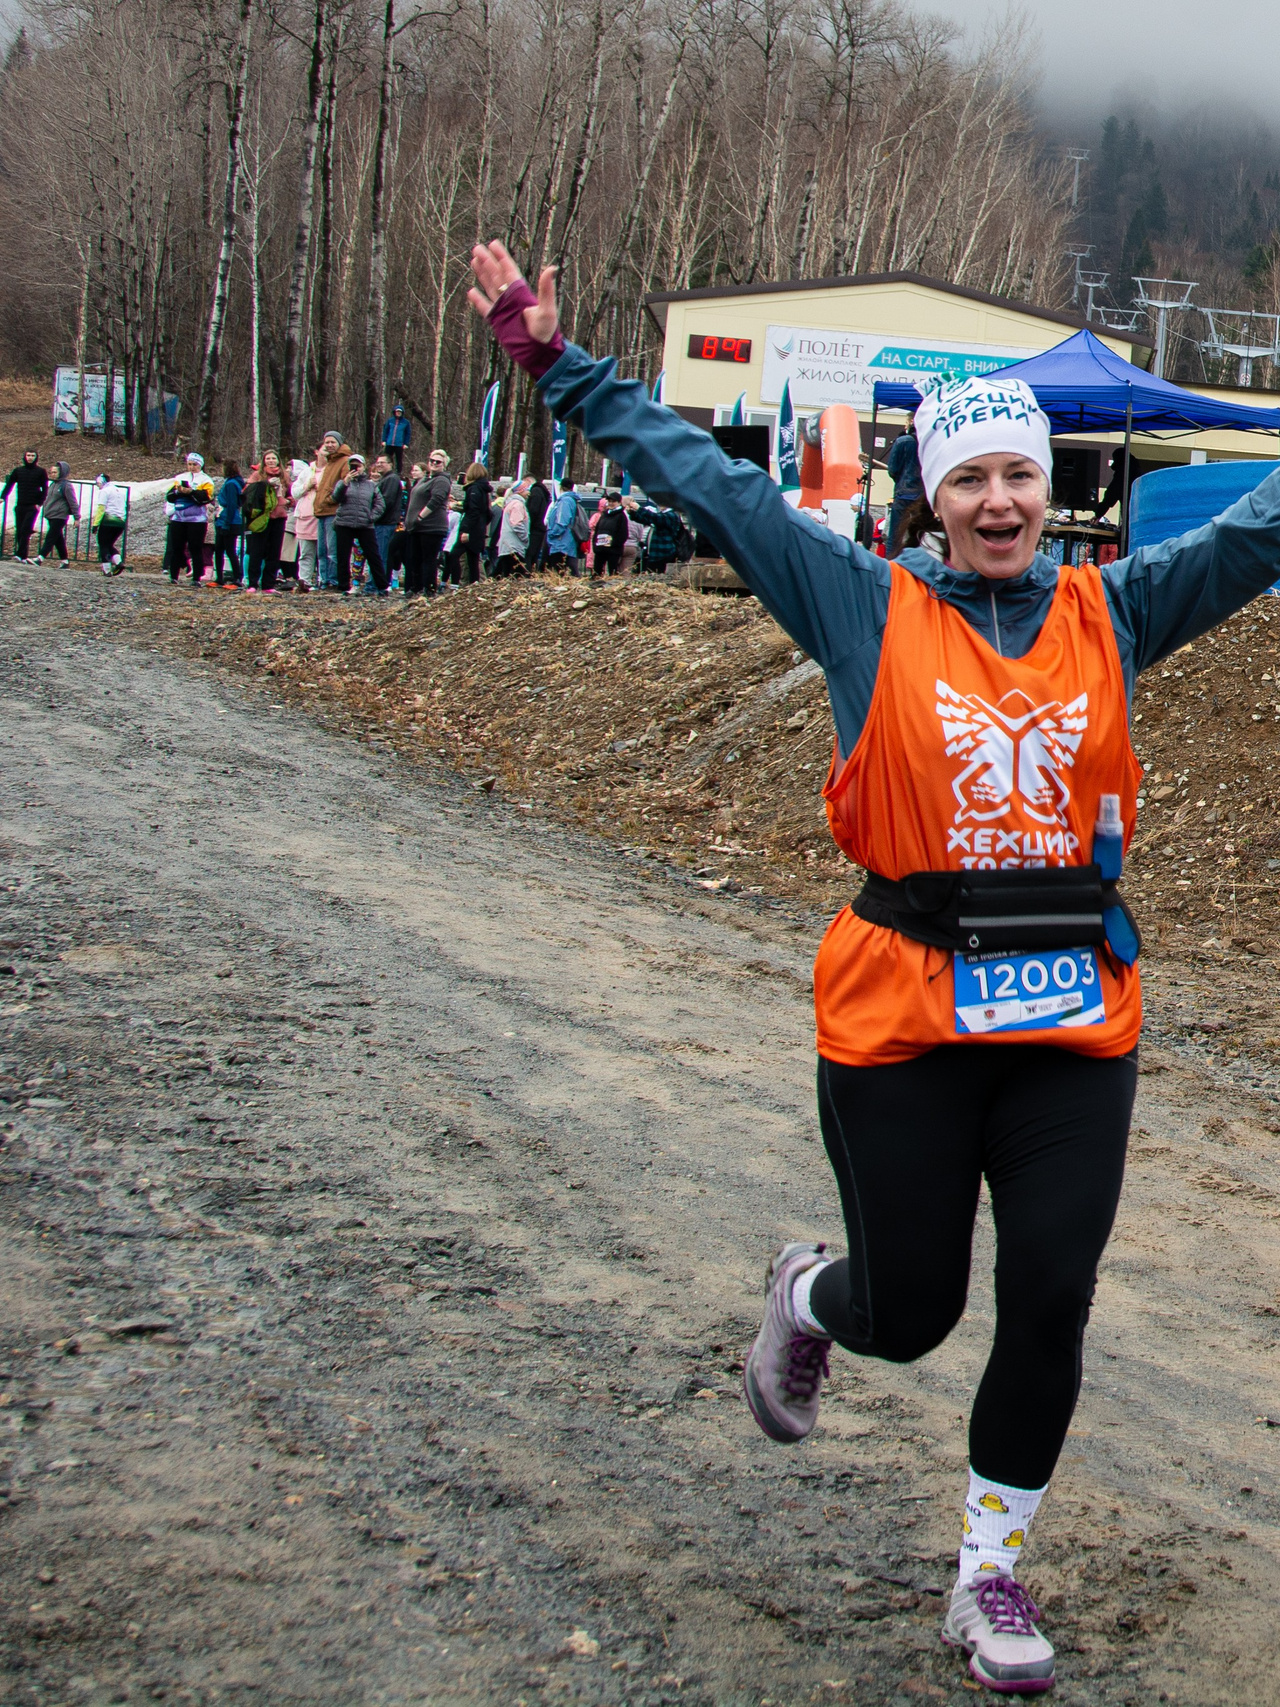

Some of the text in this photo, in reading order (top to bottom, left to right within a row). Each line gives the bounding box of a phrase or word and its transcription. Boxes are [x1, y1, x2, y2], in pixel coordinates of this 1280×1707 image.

[881, 352, 902, 365] НА
[905, 354, 961, 371] СТАРТ...
[796, 367, 857, 386] ЖИЛОЙ
[947, 827, 1079, 856] ХЕХЦИР
[971, 952, 1095, 1000] 12003
